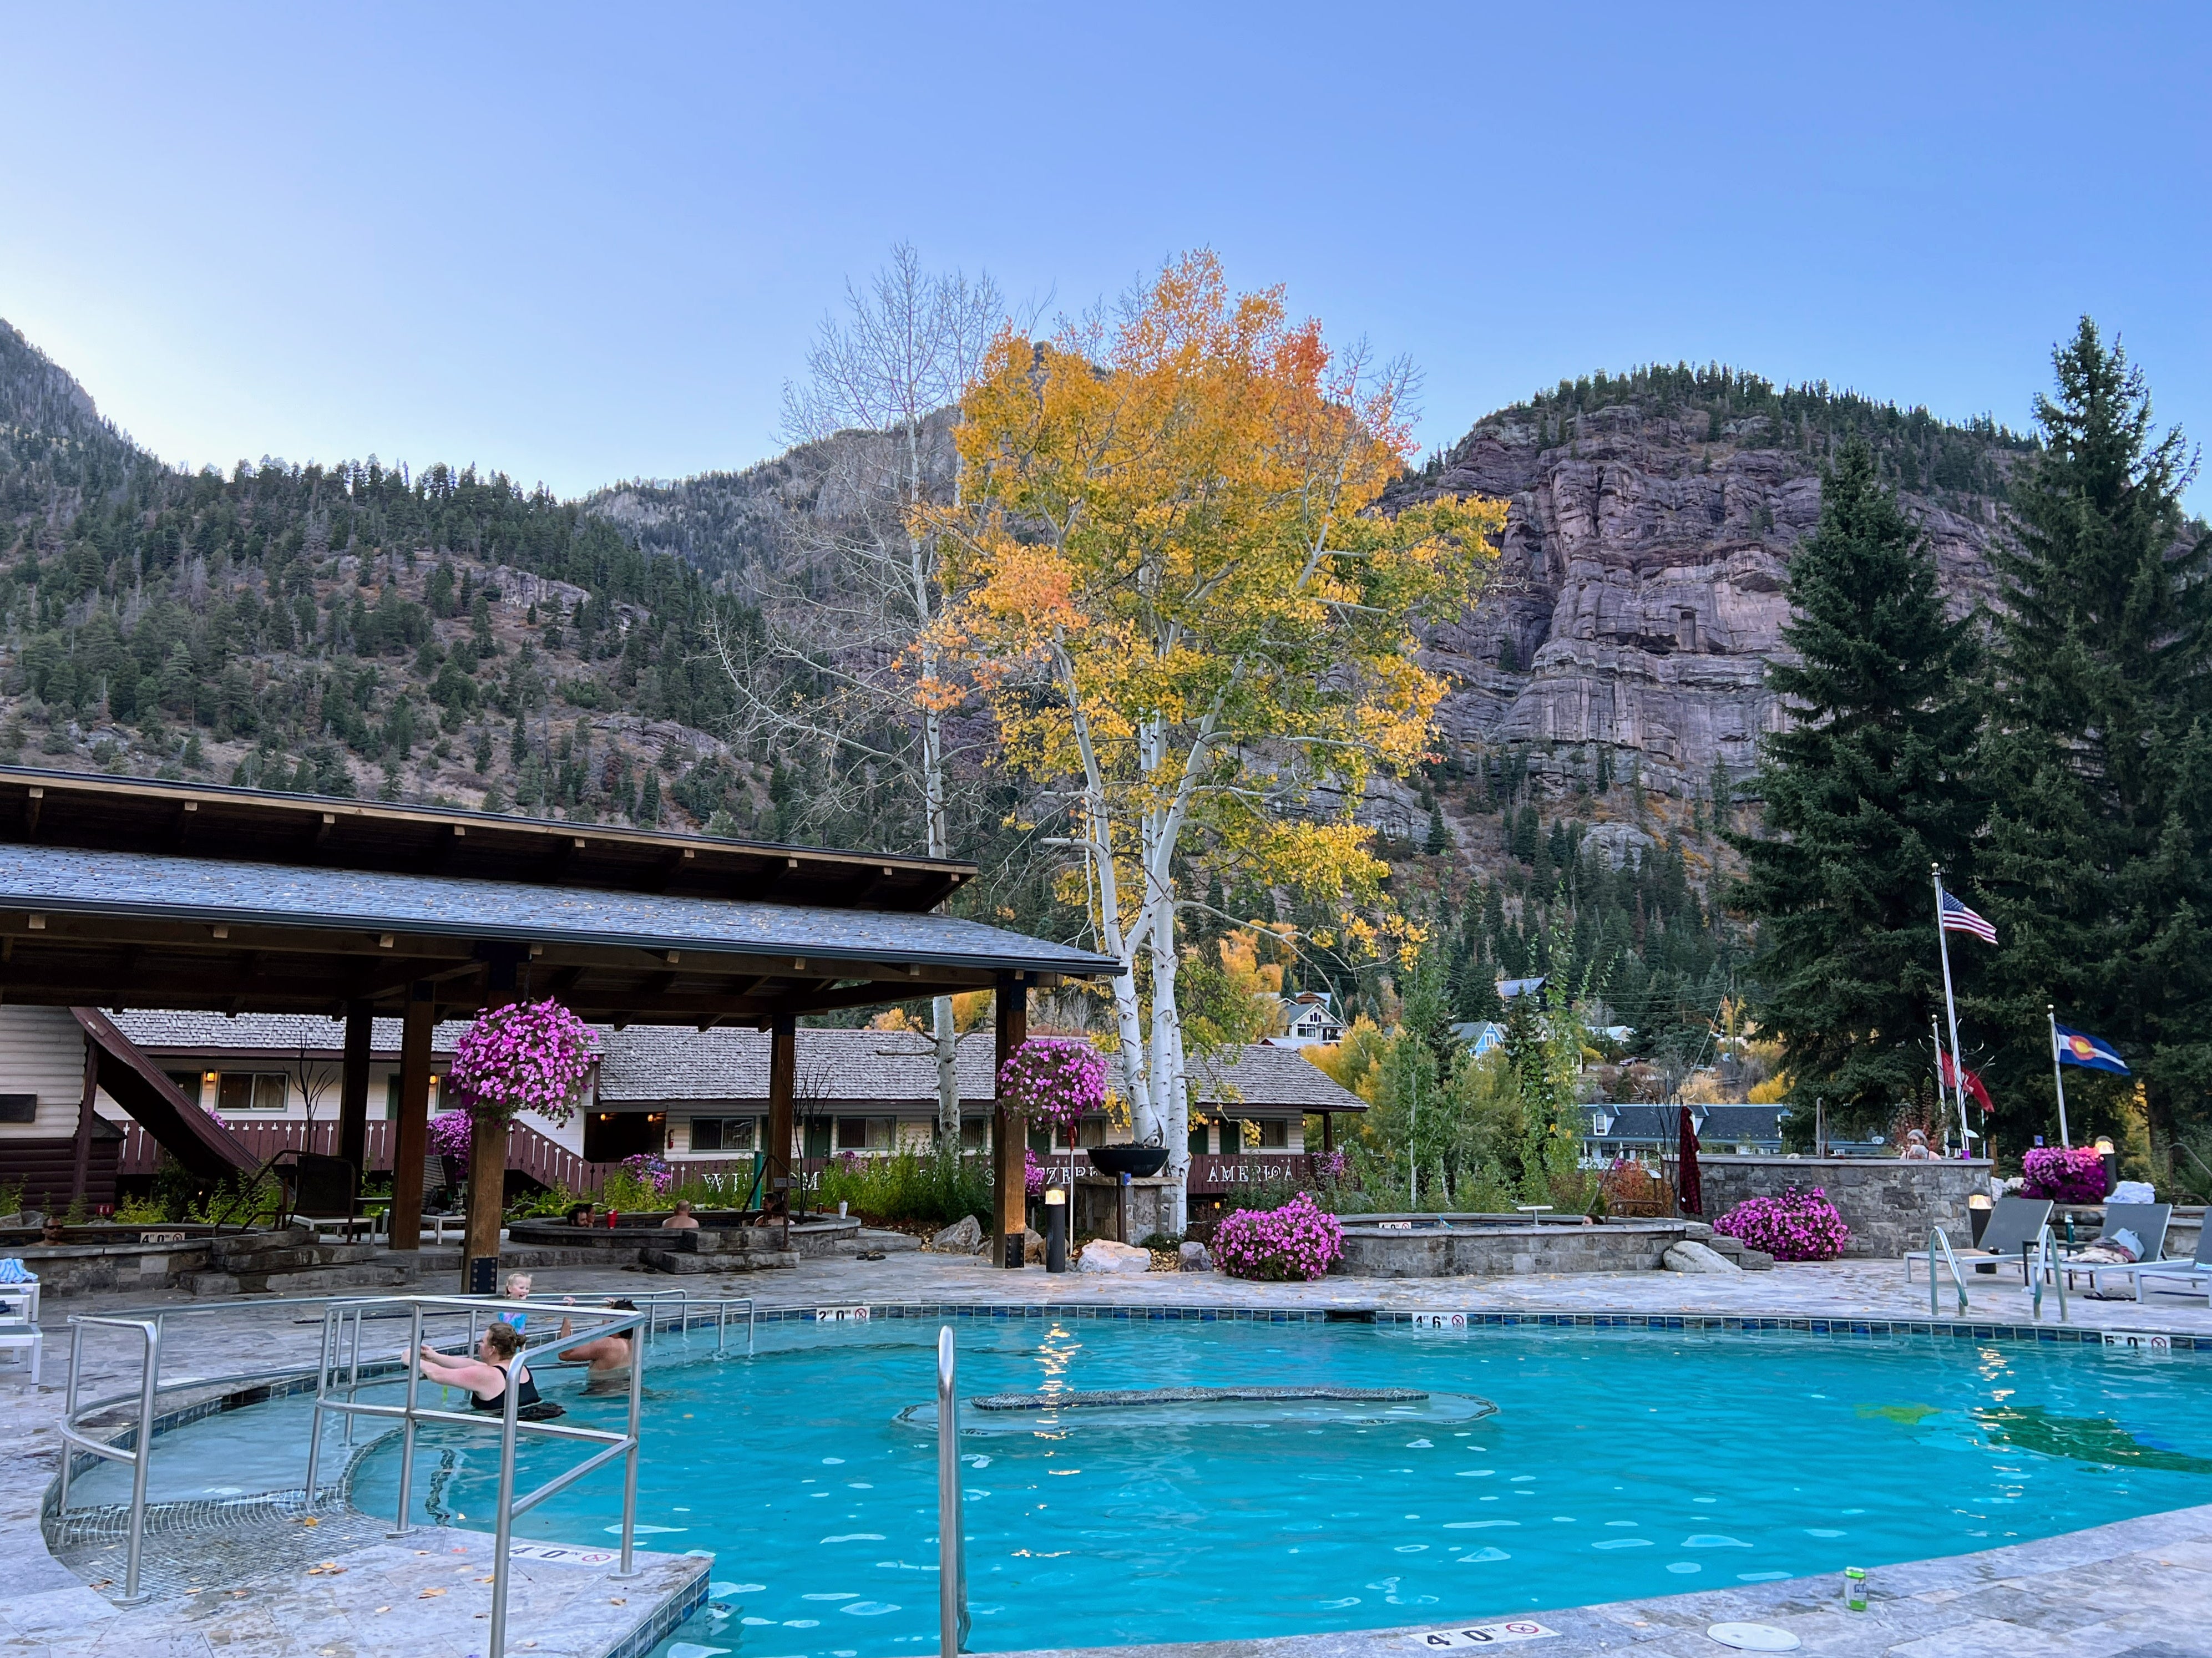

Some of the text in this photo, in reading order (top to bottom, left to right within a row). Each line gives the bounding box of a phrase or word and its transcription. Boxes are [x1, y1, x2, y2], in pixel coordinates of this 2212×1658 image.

[1206, 1165, 1293, 1182] AMERICA
[157, 1234, 165, 1243] 0
[819, 1311, 827, 1321] 2
[836, 1310, 844, 1321] 0
[1415, 1316, 1423, 1326] 4
[1433, 1316, 1441, 1328] 6
[2104, 1336, 2115, 1345] 5
[2127, 1337, 2138, 1348] 0
[1426, 1635, 1452, 1646] 4
[1461, 1630, 1494, 1641] 0
